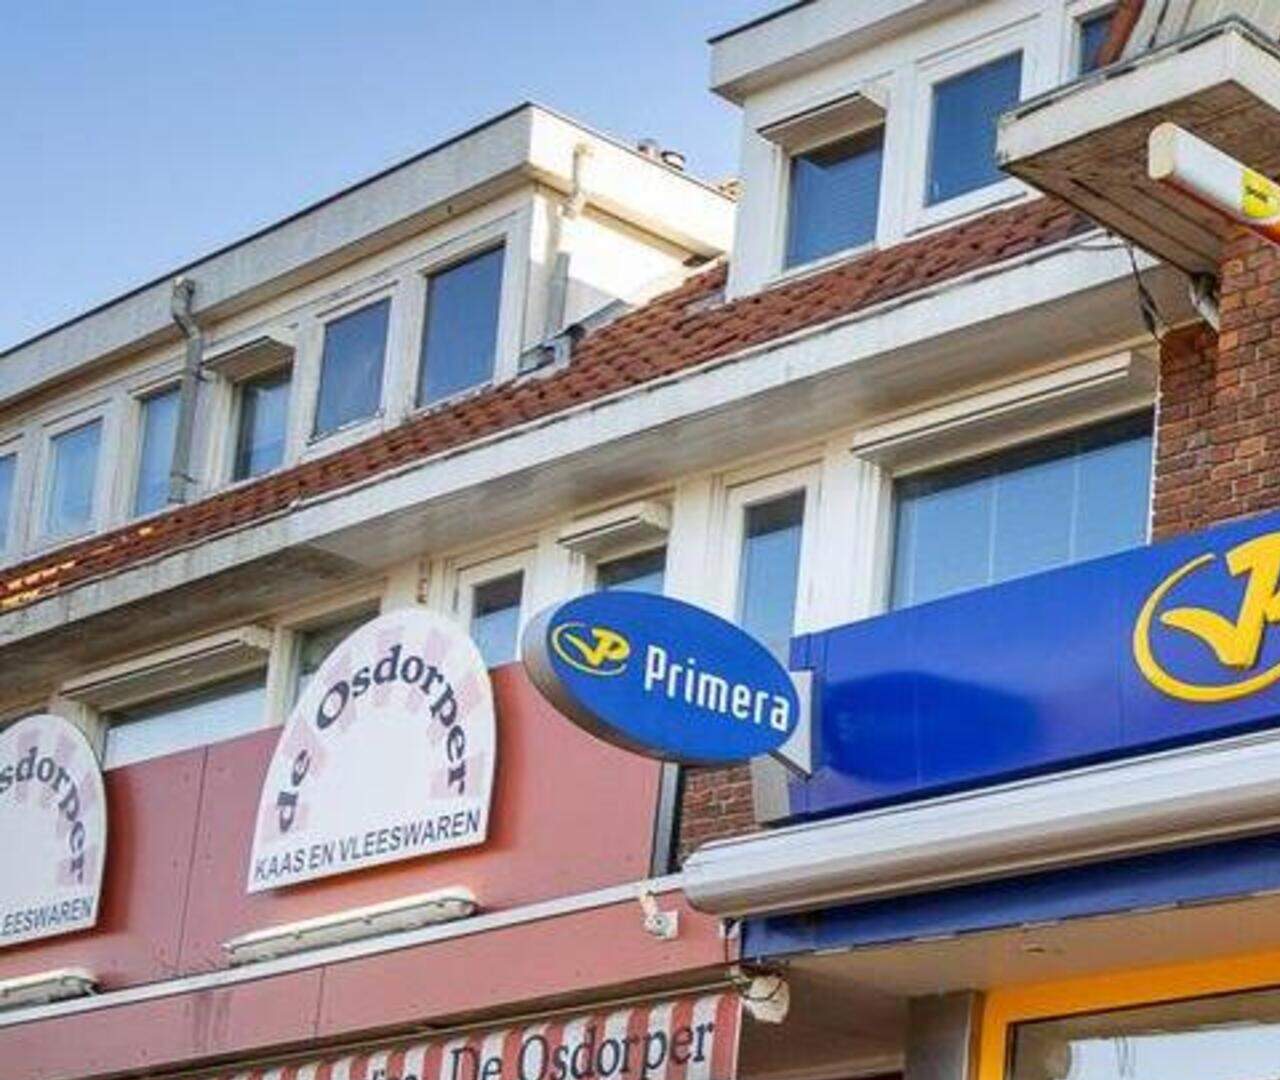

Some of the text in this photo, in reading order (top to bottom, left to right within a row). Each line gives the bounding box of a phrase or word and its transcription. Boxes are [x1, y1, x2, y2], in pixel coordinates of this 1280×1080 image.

[644, 645, 789, 731] Primera
[277, 644, 466, 834] de Osdorper
[254, 808, 482, 881] KAAS EN VLEESWAREN
